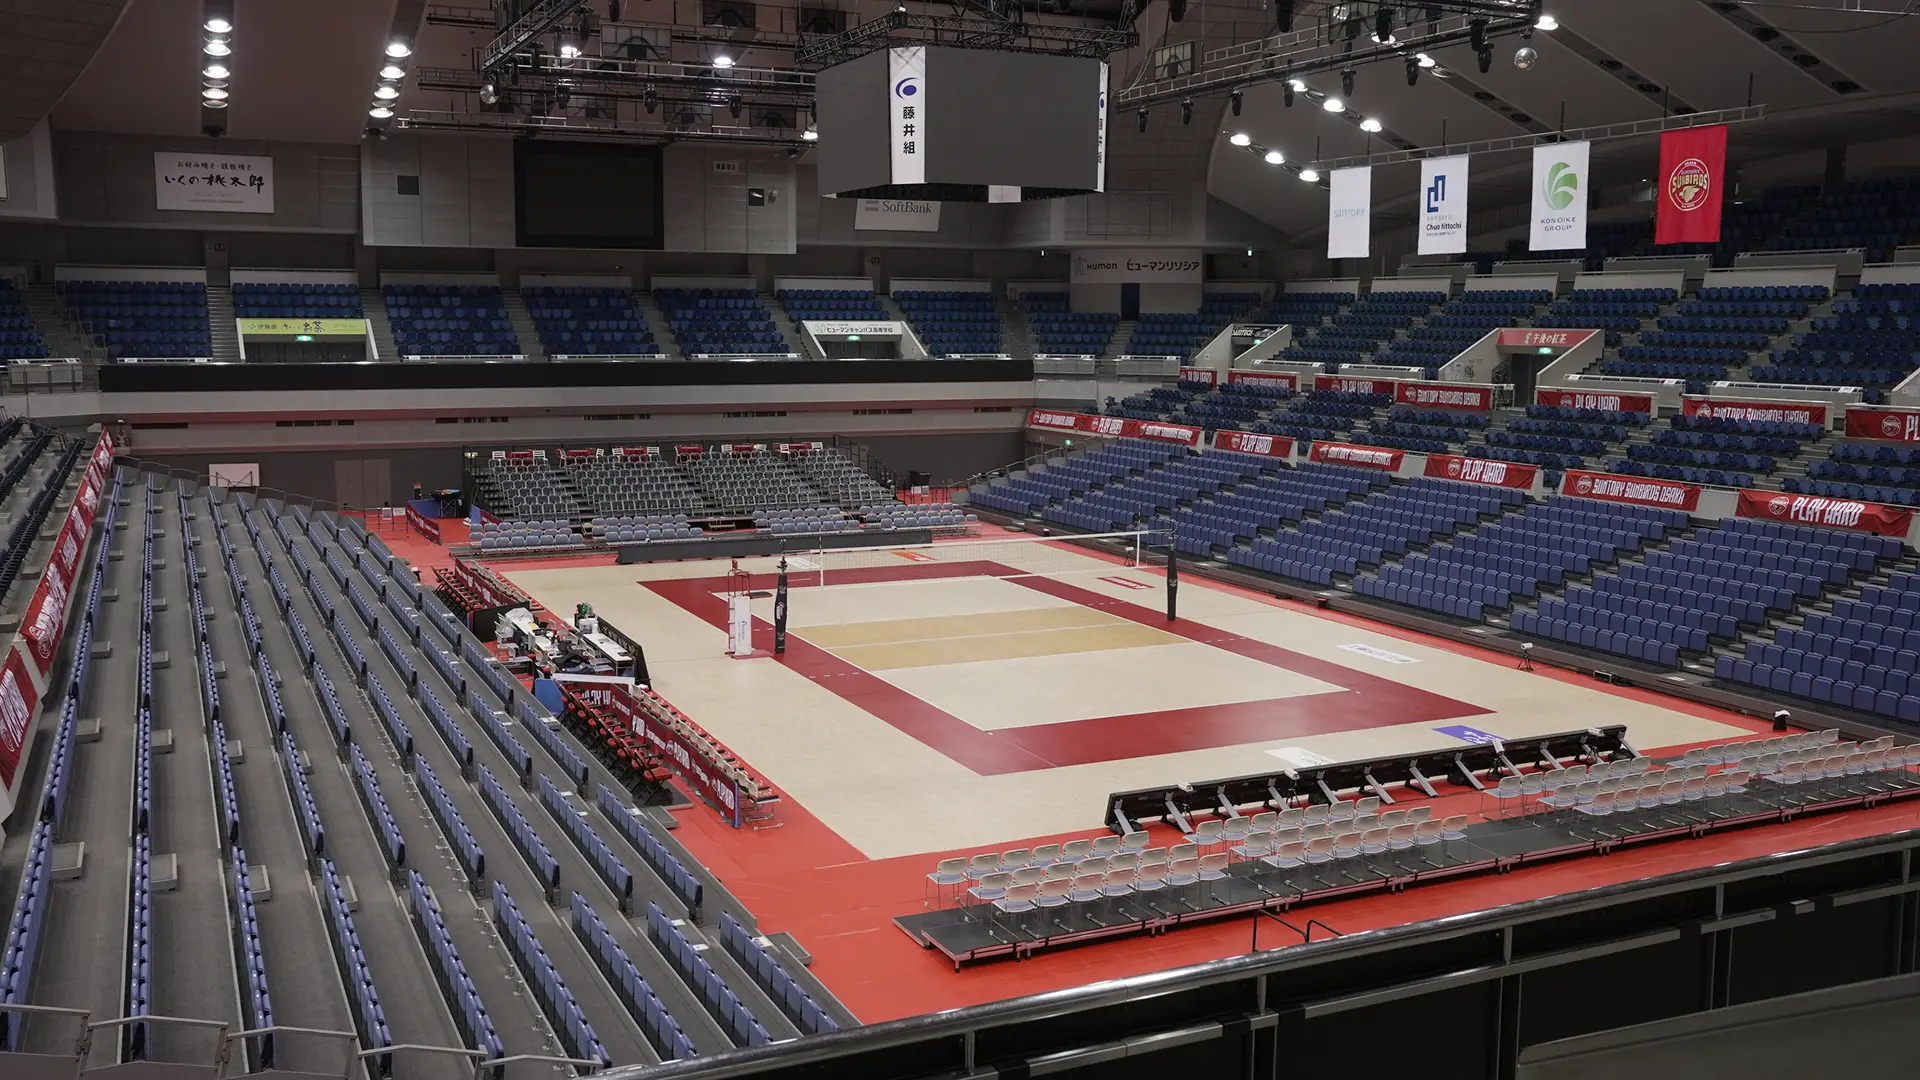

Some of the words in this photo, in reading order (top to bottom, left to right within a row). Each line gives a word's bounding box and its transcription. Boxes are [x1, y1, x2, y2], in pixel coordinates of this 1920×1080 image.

[902, 105, 916, 155] 藤井組
[164, 173, 265, 195] いくの桃太郎
[1671, 173, 1708, 194] SUNBIRDS
[881, 200, 933, 214] SoftBank
[1332, 207, 1366, 218] SUNTORY
[1426, 223, 1441, 231] Chuo
[1540, 216, 1577, 224] KONOIKE
[1126, 258, 1200, 271] ヒューマンリソシア
[1532, 332, 1568, 344] 午後の紅茶
[1460, 459, 1484, 480] PLAY
[1481, 462, 1507, 484] HARD
[1592, 478, 1625, 496] SUNTORY
[1624, 482, 1661, 501] SUNBIRDS
[1659, 486, 1686, 505] OSAKA
[1790, 496, 1828, 523] PLAY
[1823, 499, 1866, 527] HARD
